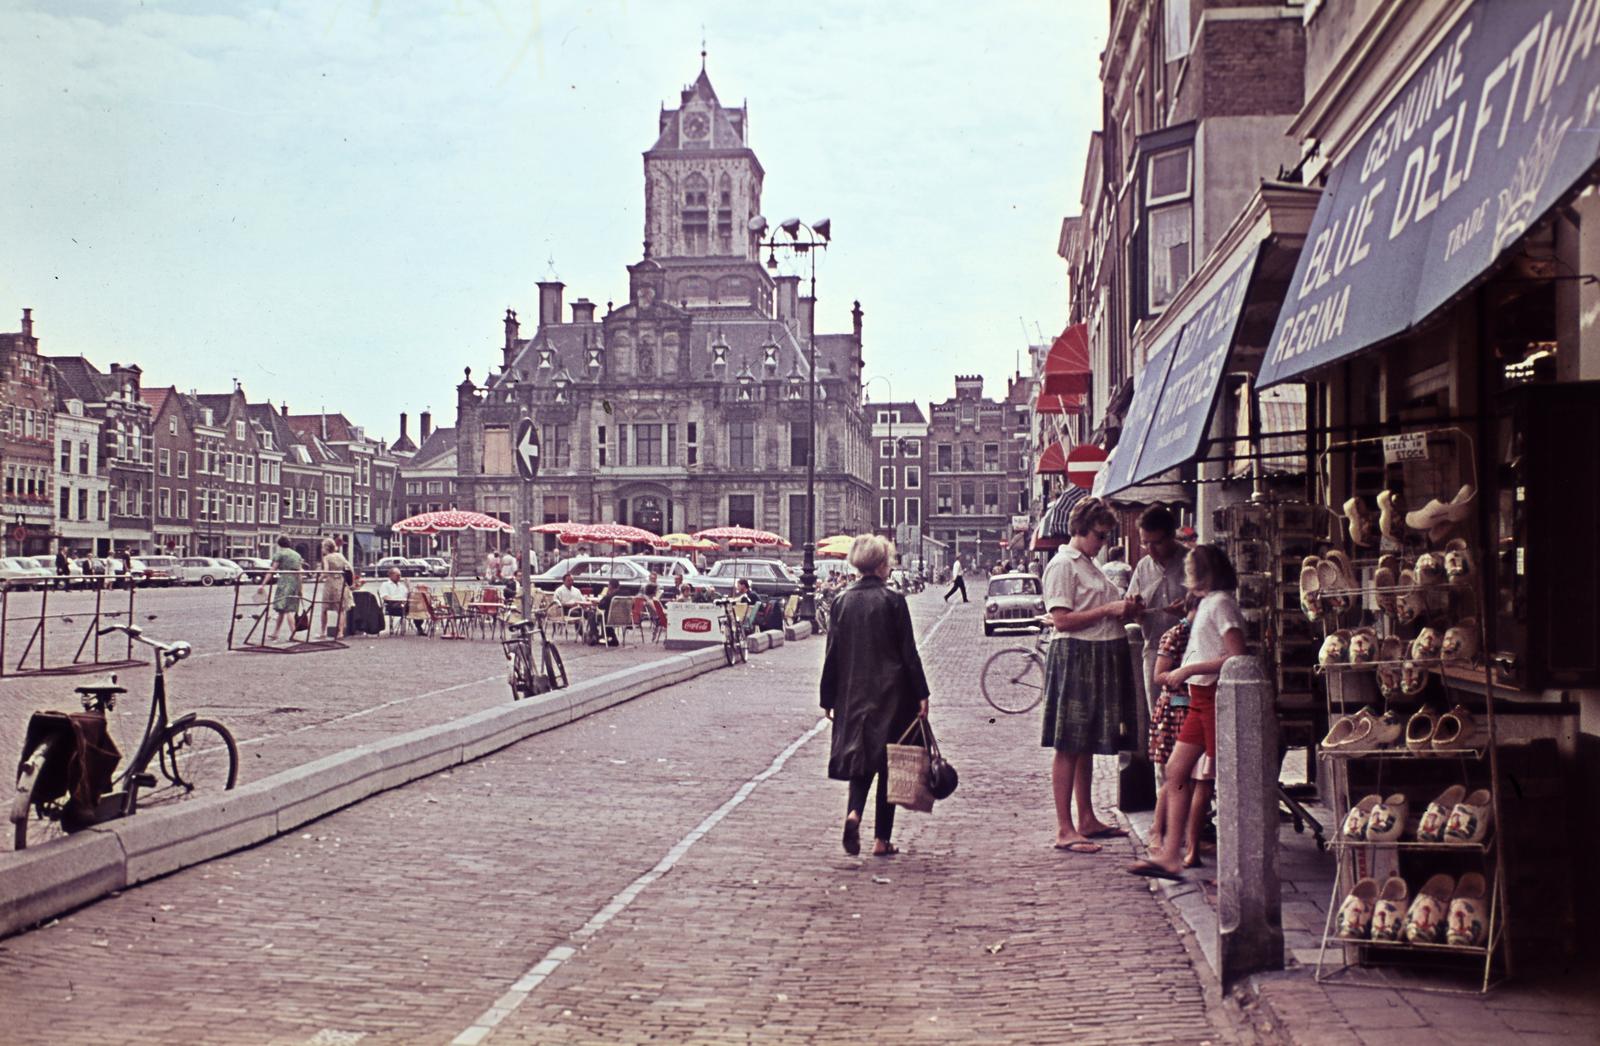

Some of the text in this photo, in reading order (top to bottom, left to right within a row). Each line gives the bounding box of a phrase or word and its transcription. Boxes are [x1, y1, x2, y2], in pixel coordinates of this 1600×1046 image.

[1298, 0, 1600, 300] BLUE DELFTWA
[1360, 22, 1473, 184] GENUINE
[1271, 285, 1352, 365] REGINA
[1396, 449, 1425, 459] STOCK
